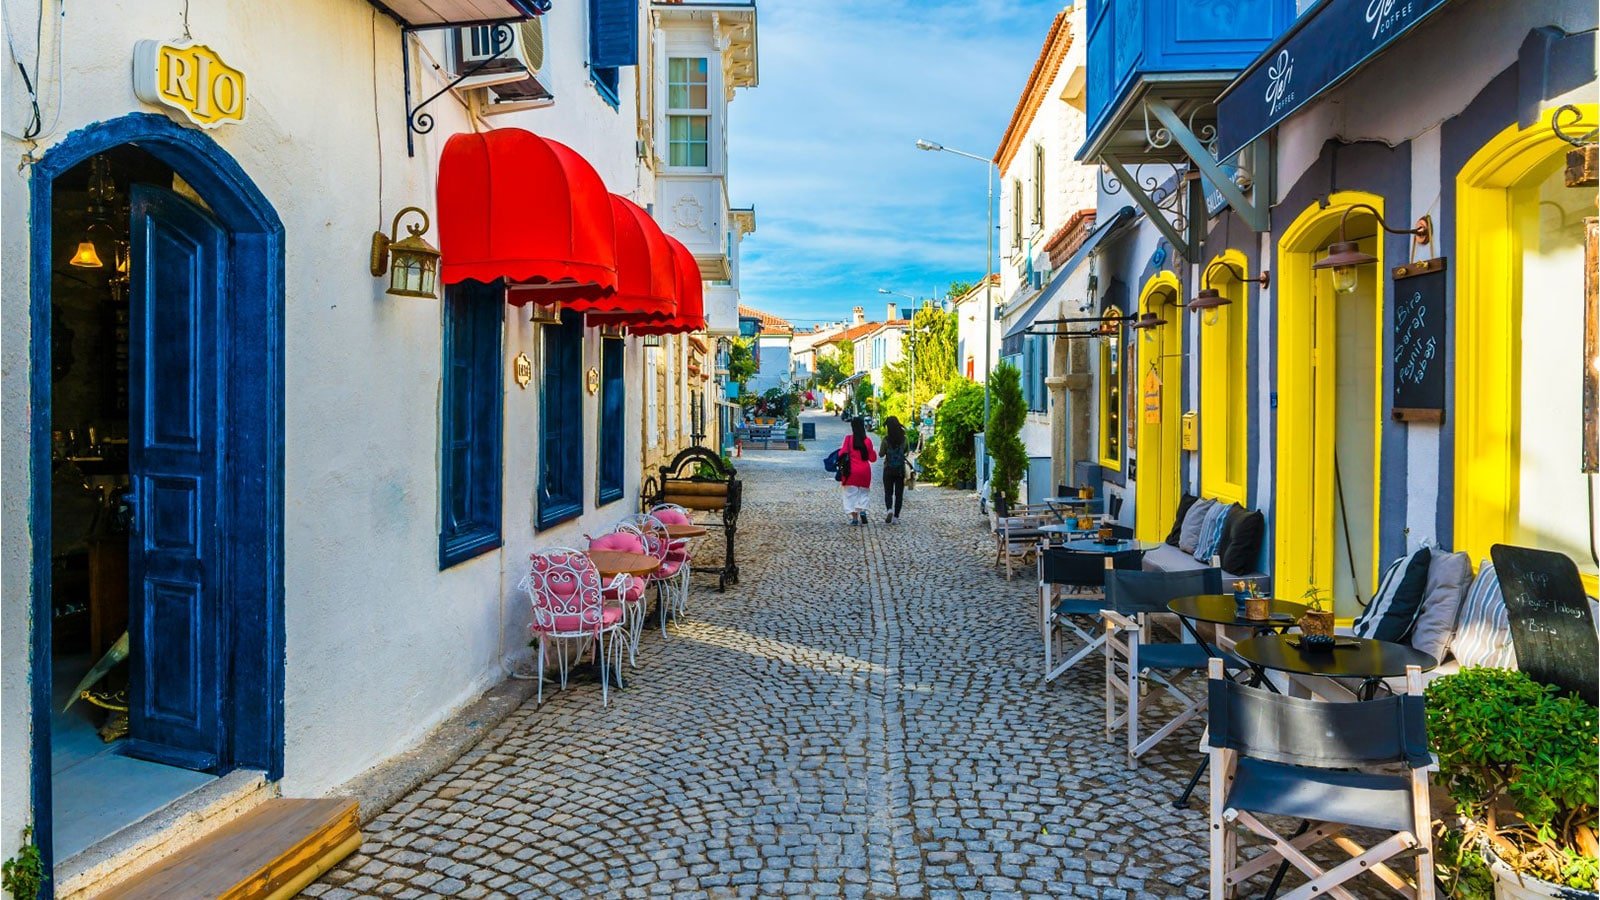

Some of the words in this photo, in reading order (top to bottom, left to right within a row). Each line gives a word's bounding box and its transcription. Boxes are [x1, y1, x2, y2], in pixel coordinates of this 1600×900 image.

[1380, 2, 1412, 33] COFFEE
[163, 52, 240, 118] RIO
[1275, 91, 1295, 112] COFFEE
[1397, 291, 1421, 326] Bira
